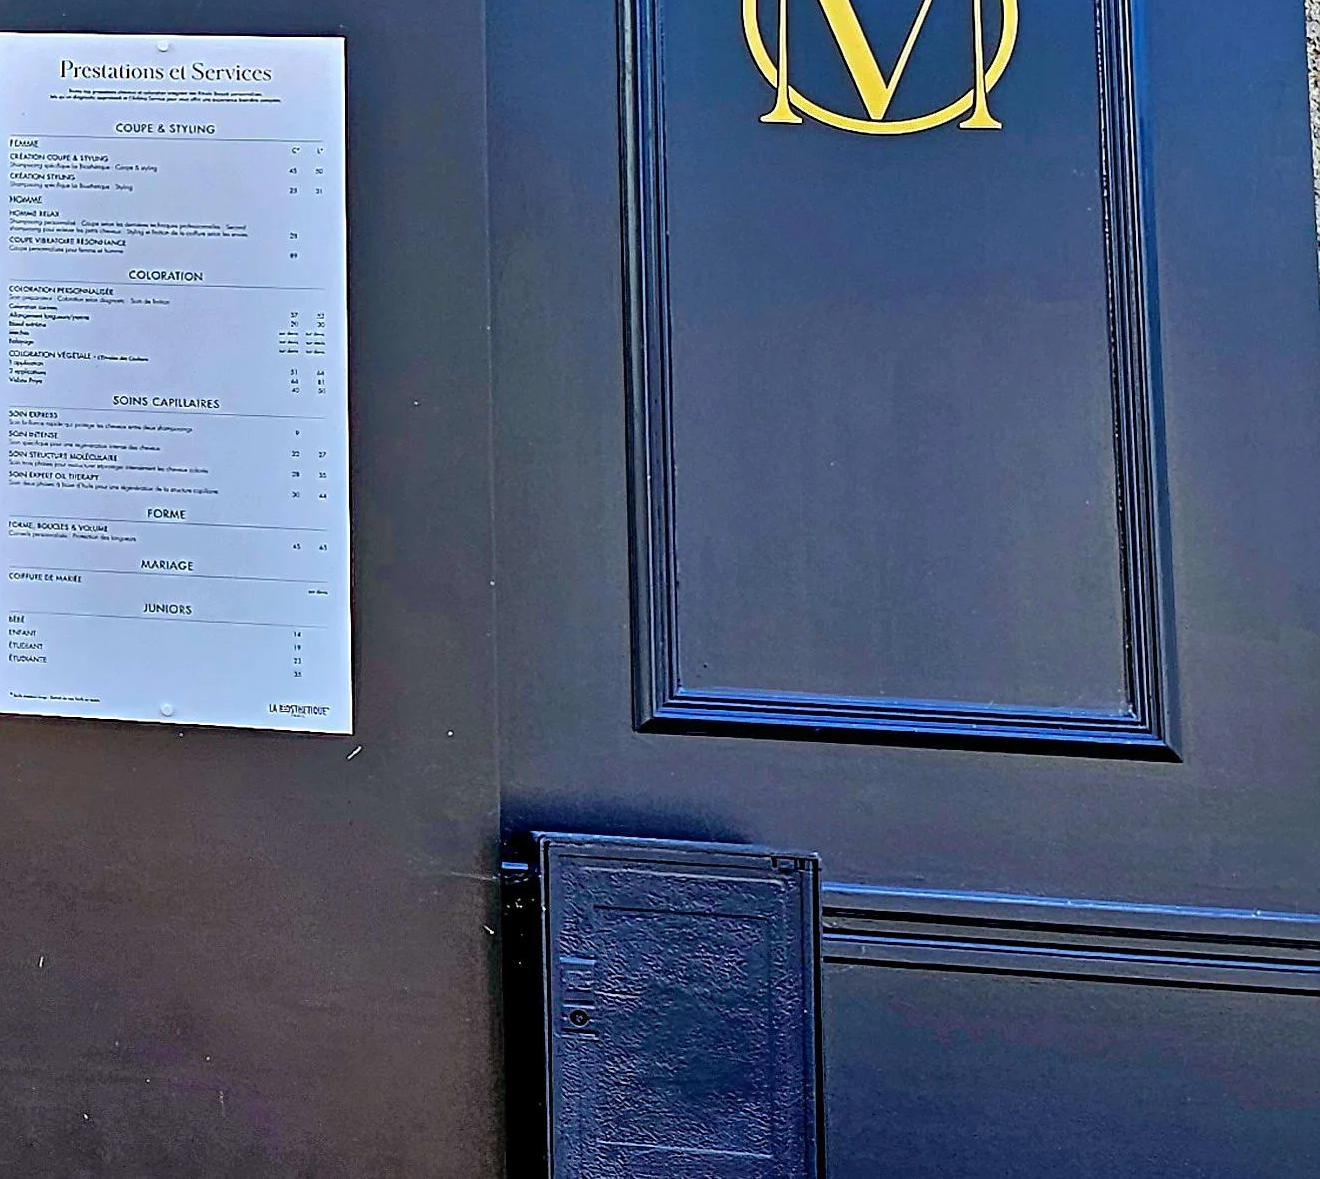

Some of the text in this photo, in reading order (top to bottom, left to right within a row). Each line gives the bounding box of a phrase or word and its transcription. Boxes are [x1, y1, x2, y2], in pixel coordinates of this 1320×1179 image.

[61, 60, 271, 81] Prestations et Services
[116, 123, 215, 134] COUPE & STYLING
[129, 270, 203, 281] COLORATION
[113, 396, 219, 408] SOINS CAPILLAIRES
[148, 509, 186, 519] FORME
[141, 560, 193, 571] MARIAGE
[143, 604, 192, 614] JUNIORS
[269, 704, 277, 712] LA
